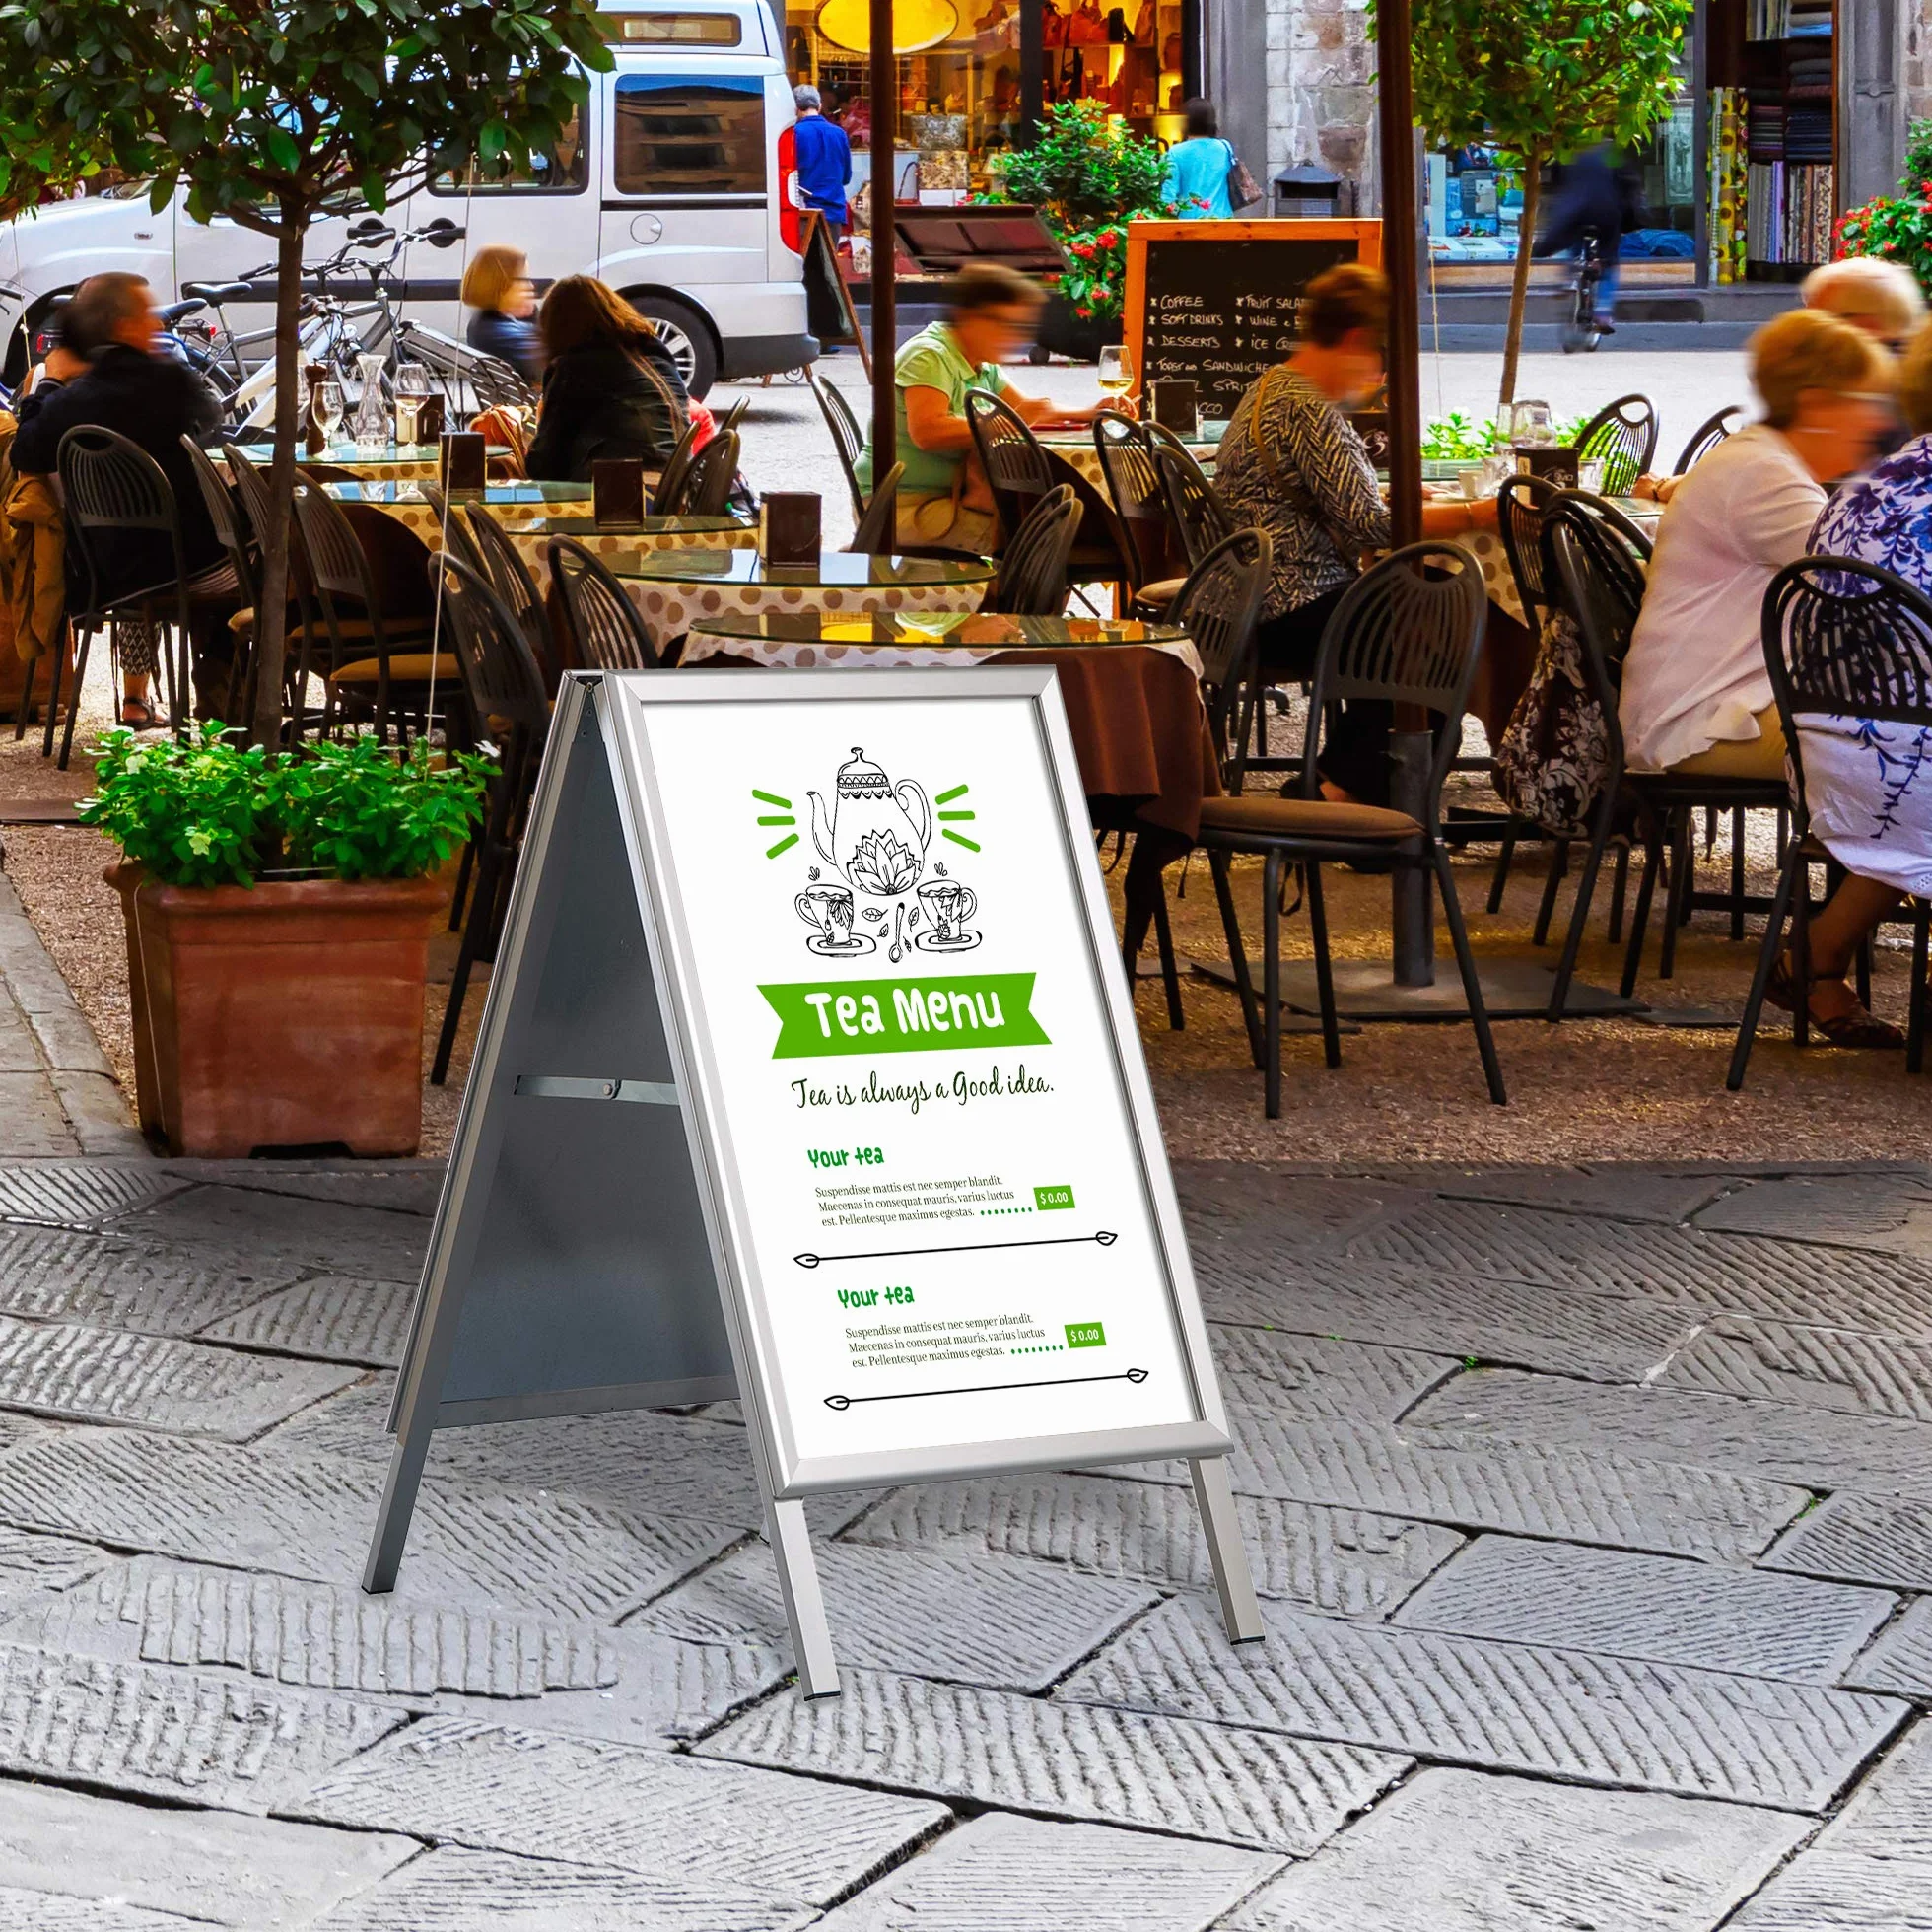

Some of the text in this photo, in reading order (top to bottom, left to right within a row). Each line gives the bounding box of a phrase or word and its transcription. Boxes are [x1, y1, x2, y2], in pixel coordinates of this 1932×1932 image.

[1160, 294, 1204, 310] COFFEE
[1245, 294, 1305, 310] FRUIT SALA
[1161, 313, 1224, 326] SOFT DRINKS
[1249, 315, 1278, 327] WINE
[1161, 334, 1221, 348] DESSERTS
[1203, 359, 1271, 373] SANDWICHE
[804, 988, 1005, 1038] Tea Menu
[791, 1064, 1054, 1115] Tea is always a Good idea.
[807, 1146, 885, 1169] Your tea
[815, 1175, 1003, 1199] Suspendisse mattis est nec semper blandit.
[818, 1190, 1014, 1212] Maecenas in consequat mauris, varius luctus
[821, 1208, 974, 1227] est. Pellentesque maximus egestas.
[837, 1285, 915, 1309] Your tea
[845, 1313, 1034, 1340] Suspendisse mattis est nec semper blandit.
[848, 1328, 1045, 1353] Maecenas in consequat mauris, varius luctus
[852, 1346, 1005, 1368] est. Pellentesque maximus egestas.
